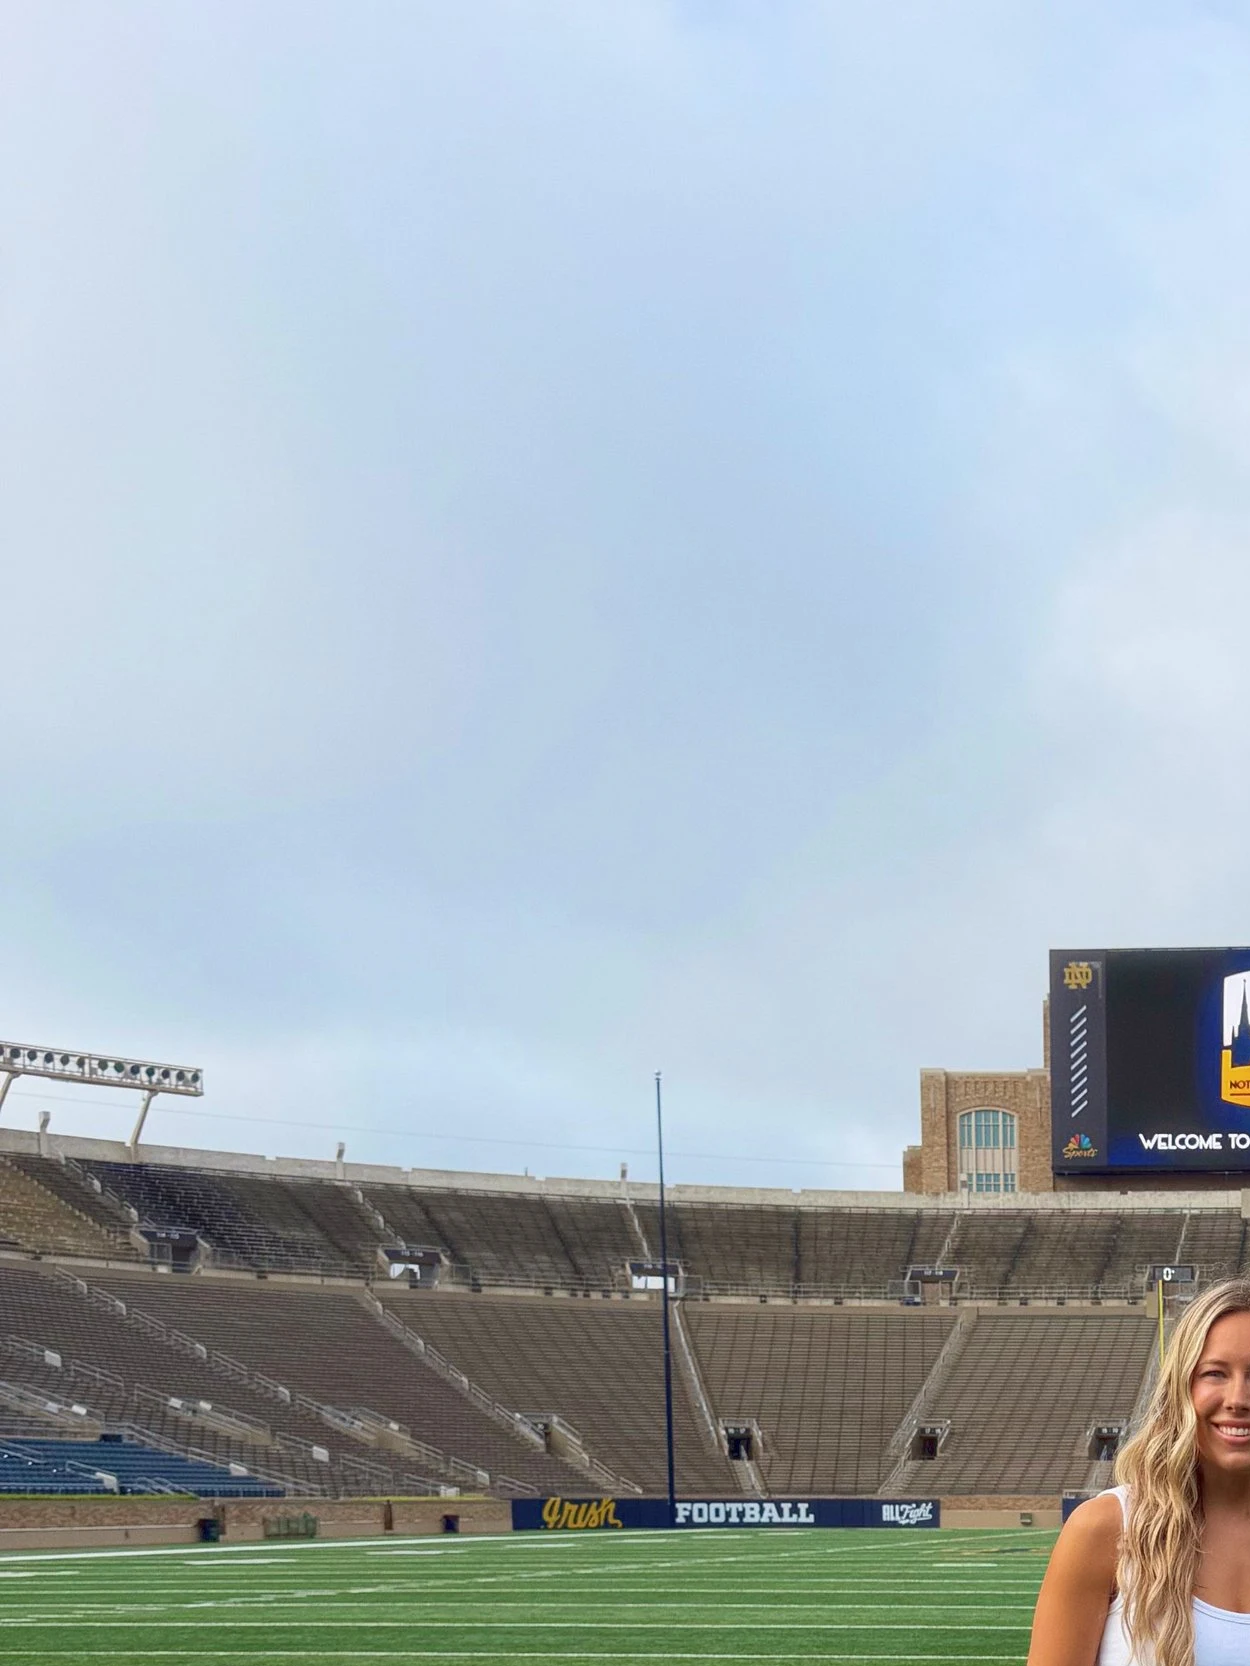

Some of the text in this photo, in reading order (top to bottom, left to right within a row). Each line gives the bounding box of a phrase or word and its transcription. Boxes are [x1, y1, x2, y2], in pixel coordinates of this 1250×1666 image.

[1138, 1133, 1223, 1151] WELCOME
[1227, 1132, 1250, 1150] TO
[543, 1497, 624, 1529] Irish
[675, 1502, 815, 1524] FOOTBALL
